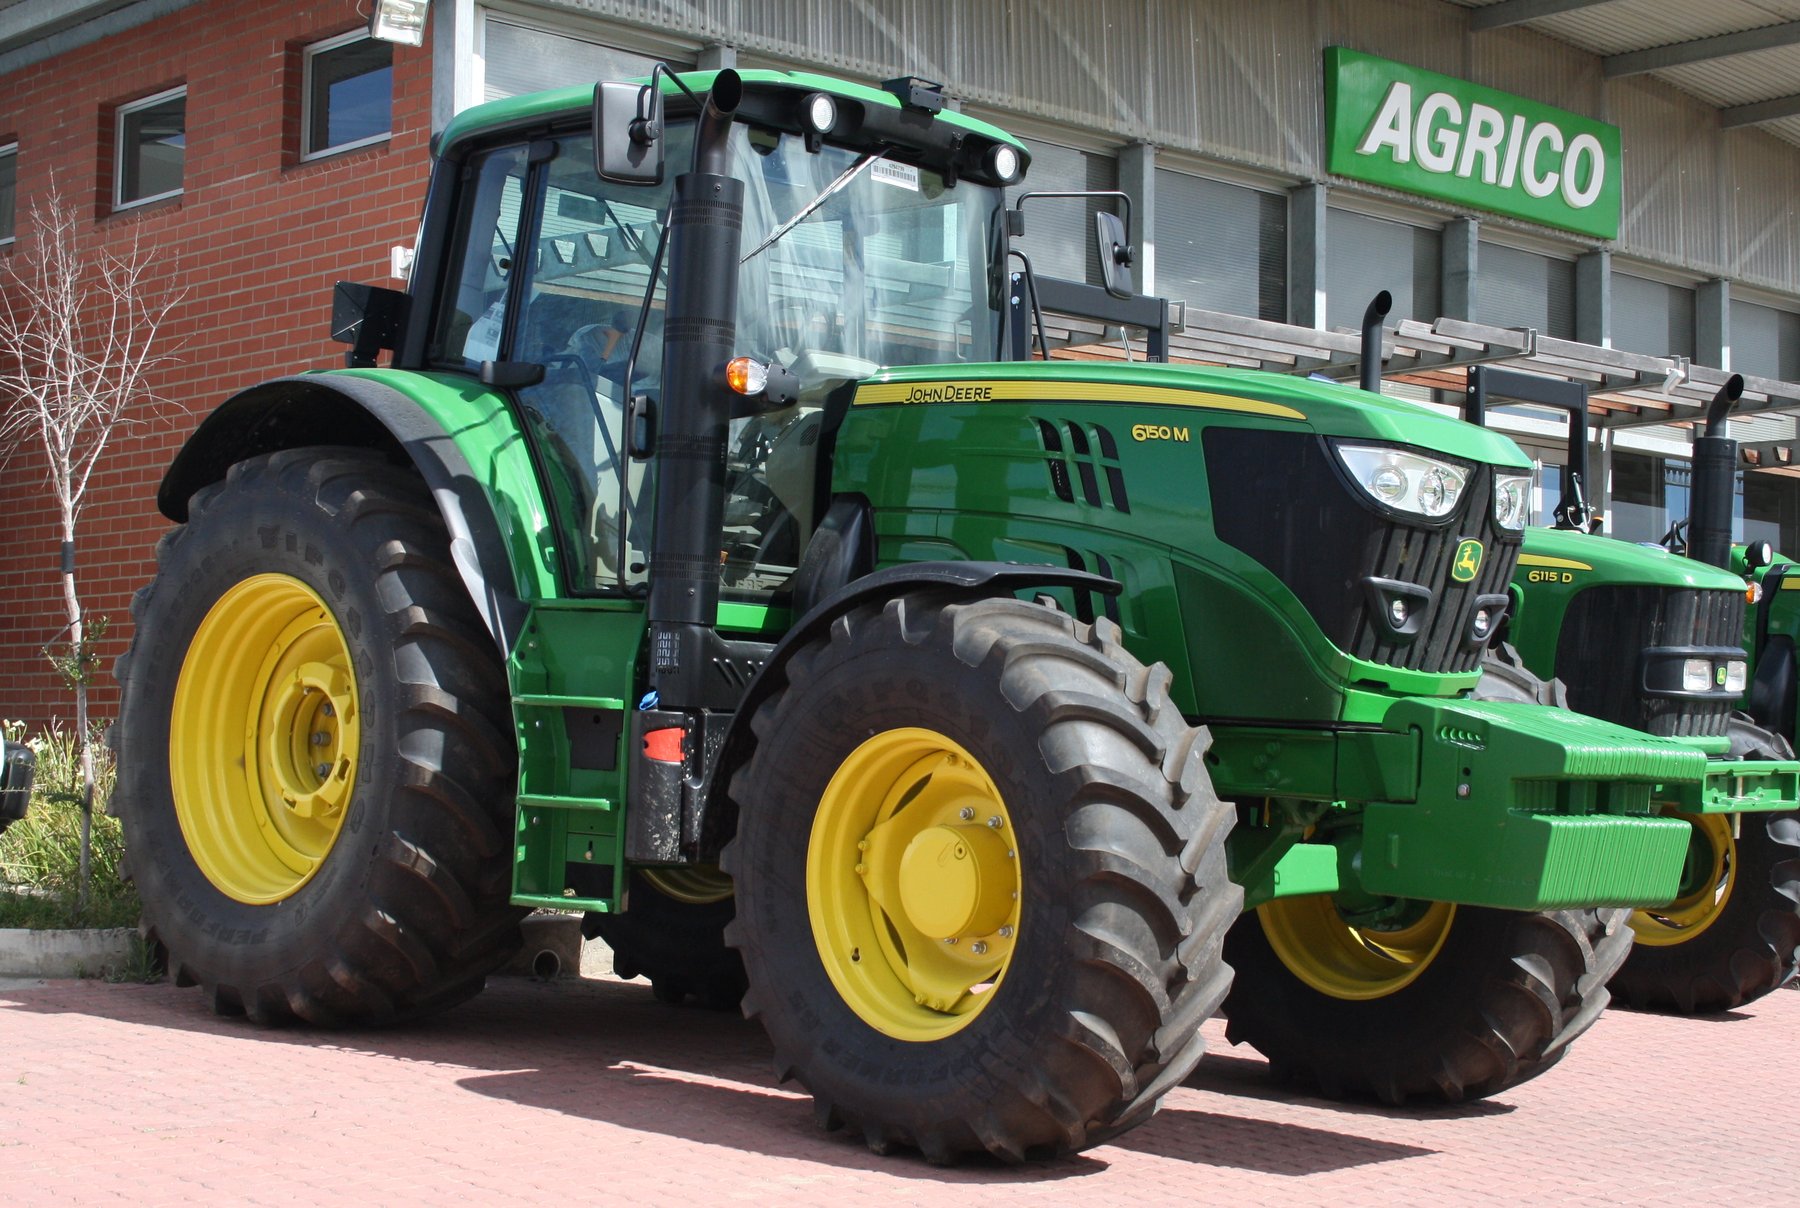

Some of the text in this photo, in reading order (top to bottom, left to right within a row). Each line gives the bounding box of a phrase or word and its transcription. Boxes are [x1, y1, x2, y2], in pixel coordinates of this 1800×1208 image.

[1355, 81, 1605, 209] AGRICO
[905, 385, 993, 402] JOHN DEERE
[1131, 423, 1190, 443] 6150 M
[1528, 570, 1574, 584] 6115 D
